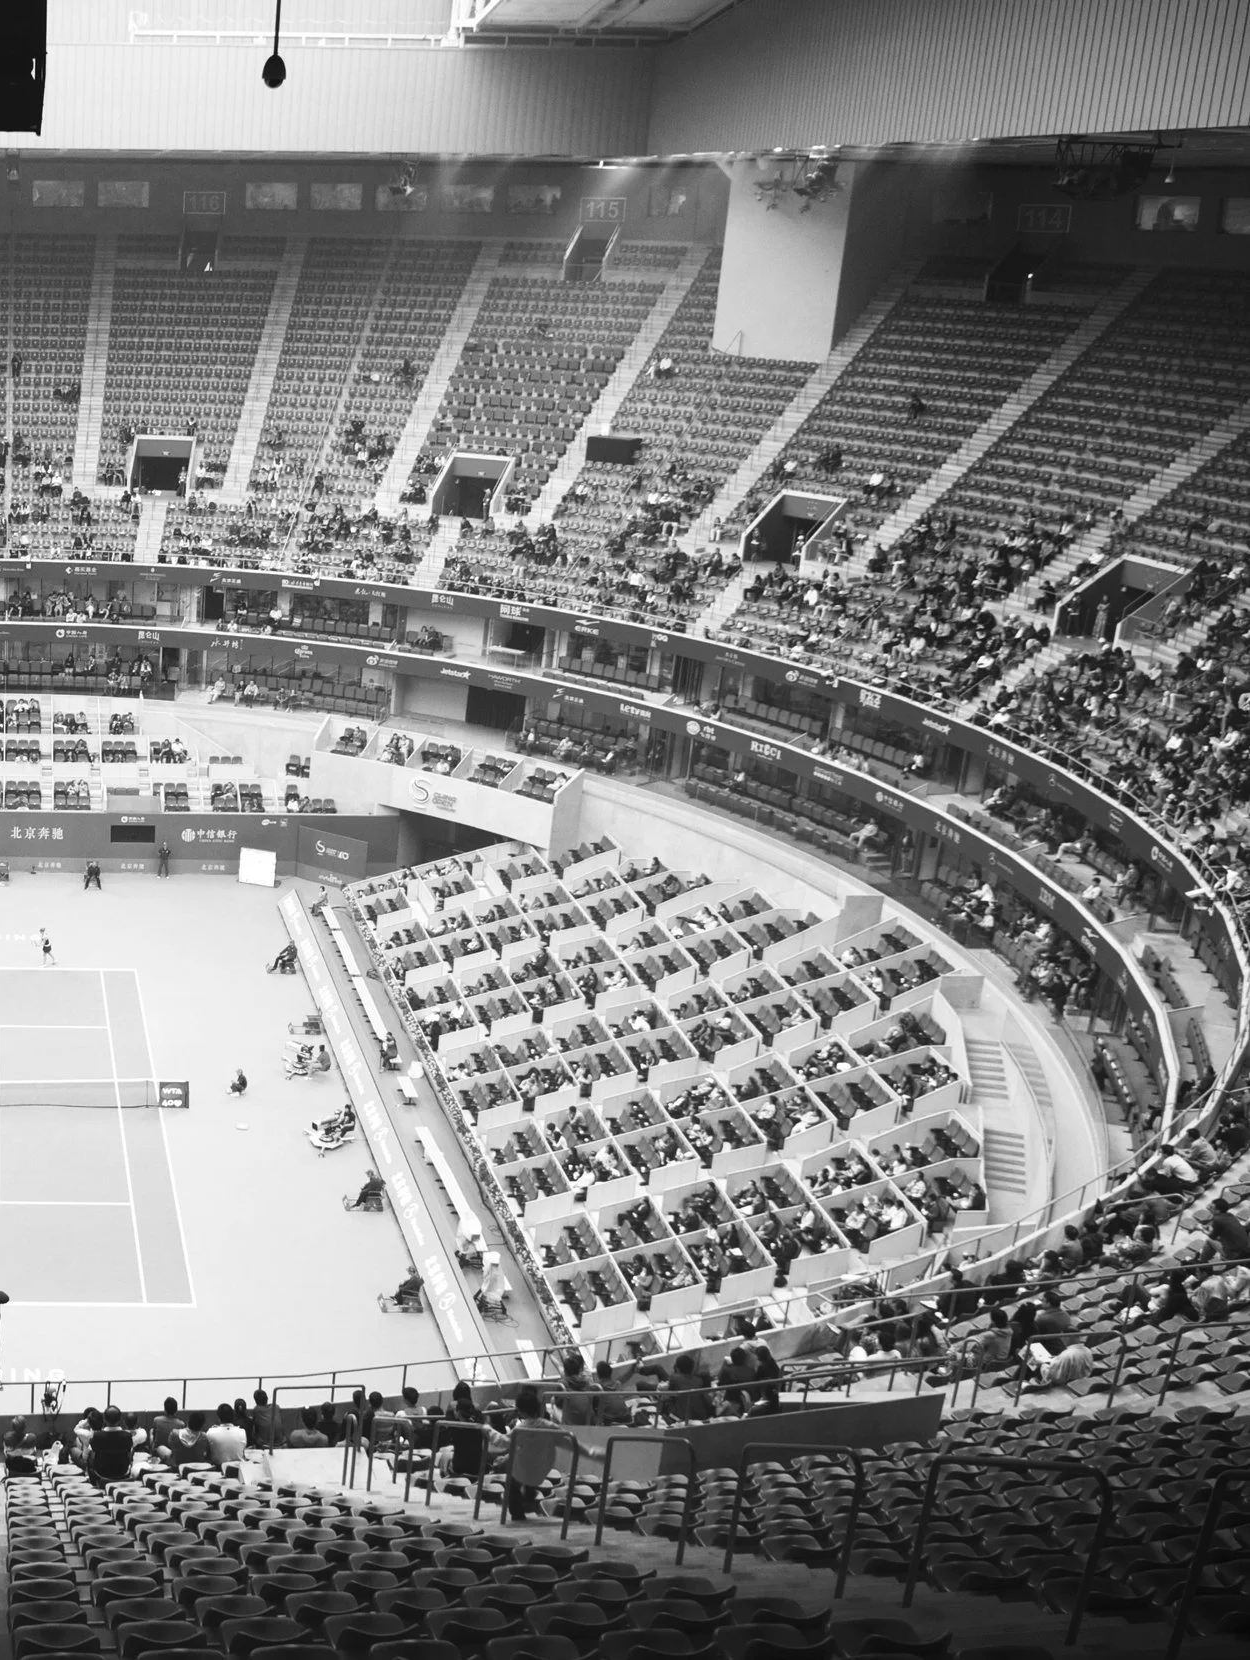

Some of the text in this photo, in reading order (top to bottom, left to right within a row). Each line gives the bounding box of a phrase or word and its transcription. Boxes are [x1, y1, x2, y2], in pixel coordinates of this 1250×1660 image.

[187, 193, 222, 212] 116
[584, 200, 620, 218] 115
[1025, 208, 1063, 230] 114
[432, 594, 454, 606] 昆仑山
[137, 631, 160, 641] 昆仑山
[574, 625, 600, 636] ERKE
[440, 667, 469, 680] Jetstar
[10, 826, 64, 840] 北京奔驰
[197, 828, 238, 840] 中信银行
[162, 1086, 183, 1096] WTA
